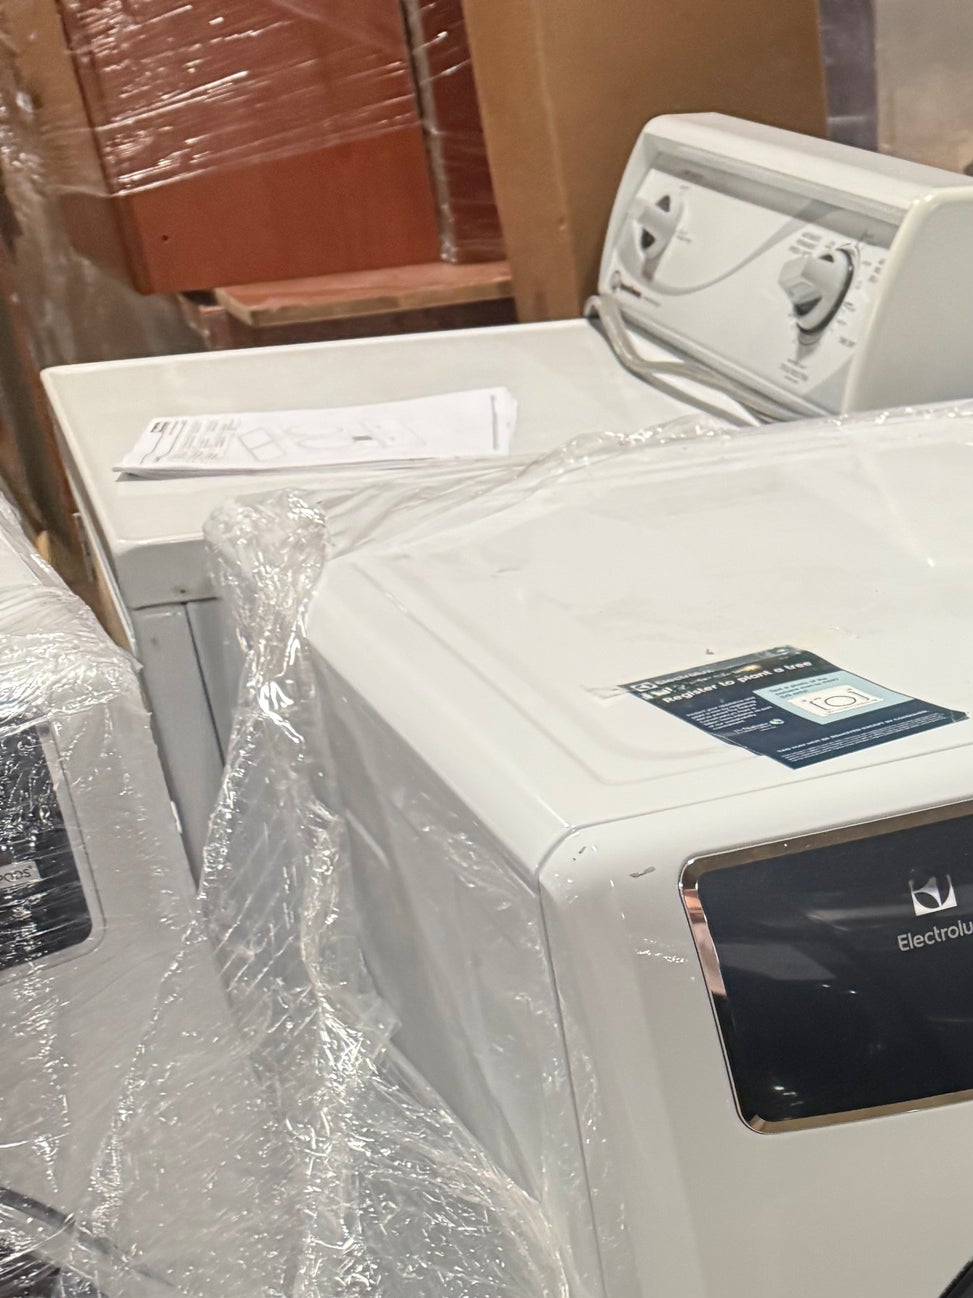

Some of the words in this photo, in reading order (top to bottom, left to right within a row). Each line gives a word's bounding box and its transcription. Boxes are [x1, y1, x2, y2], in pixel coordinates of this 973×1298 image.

[662, 683, 718, 703] Register
[719, 678, 736, 687] to
[737, 669, 773, 683] plant
[785, 660, 813, 670] tree
